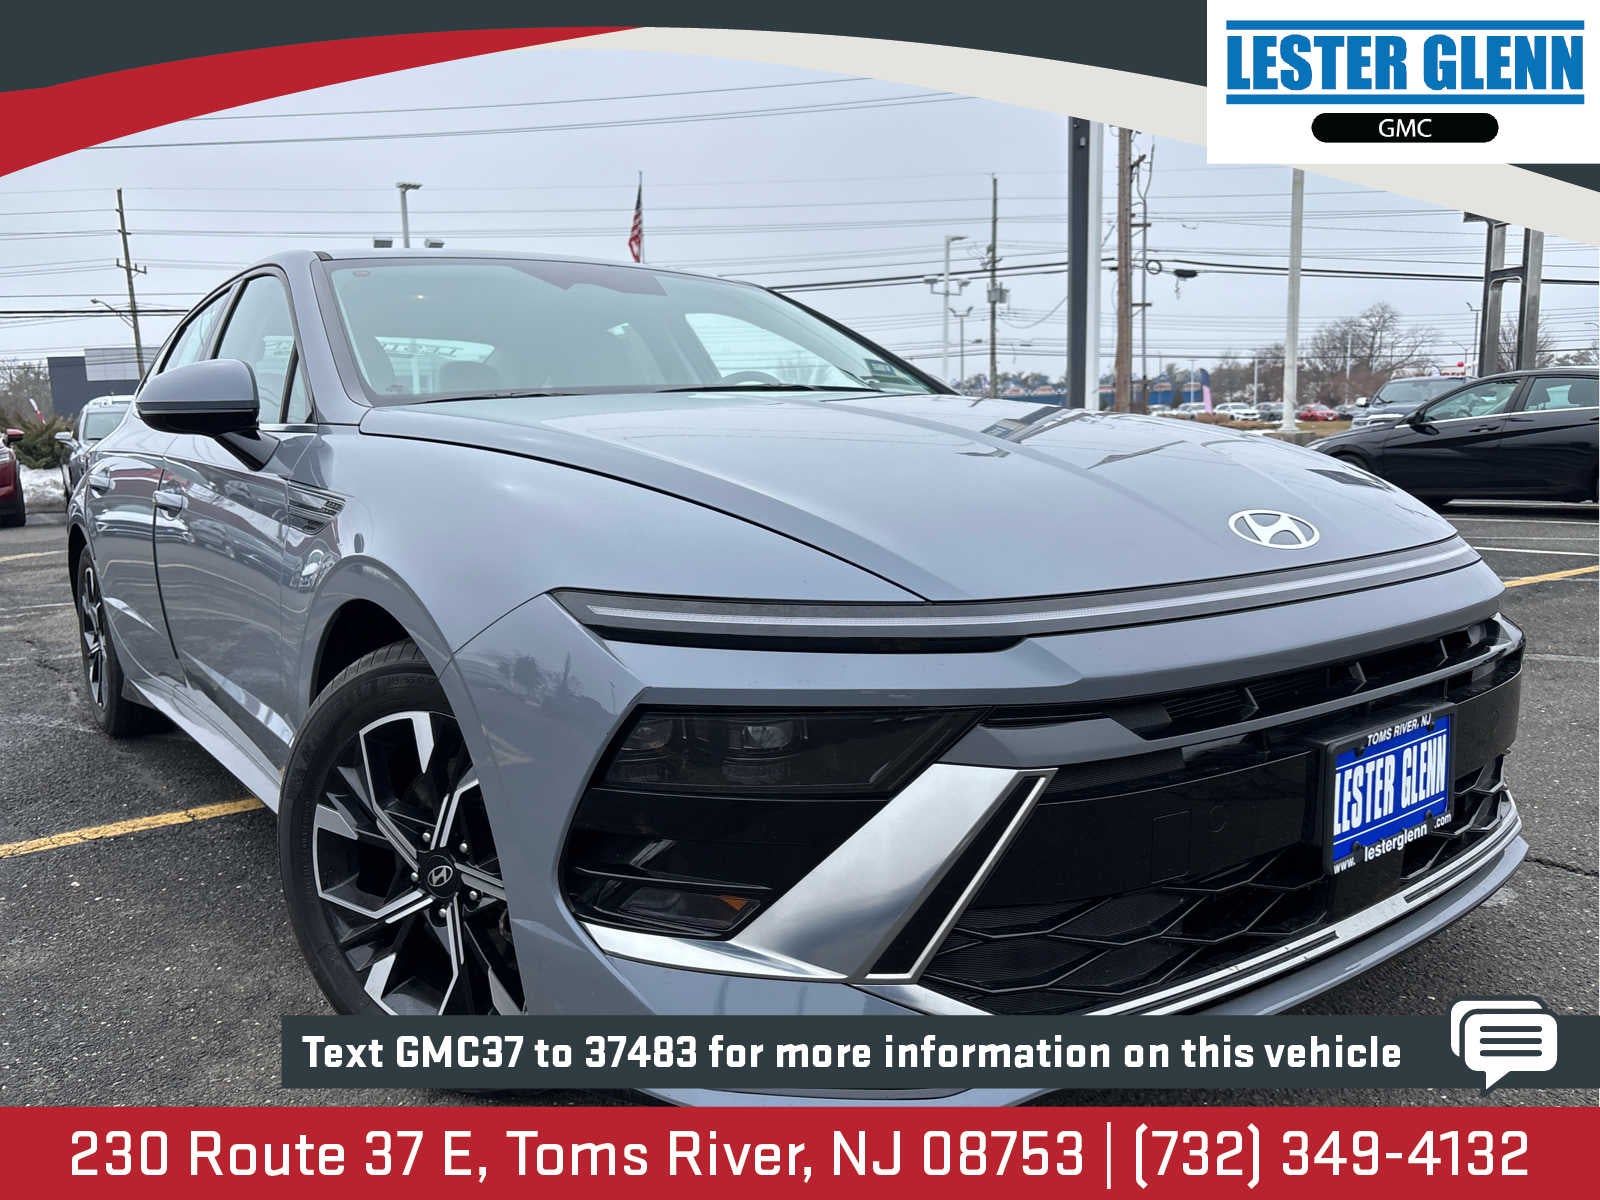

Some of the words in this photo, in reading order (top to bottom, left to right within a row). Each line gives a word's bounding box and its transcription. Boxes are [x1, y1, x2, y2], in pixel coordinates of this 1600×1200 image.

[1367, 728, 1392, 746] TOMS
[1420, 713, 1432, 727] NJ
[1333, 754, 1395, 836] LESTER
[1401, 734, 1447, 809] GLENN
